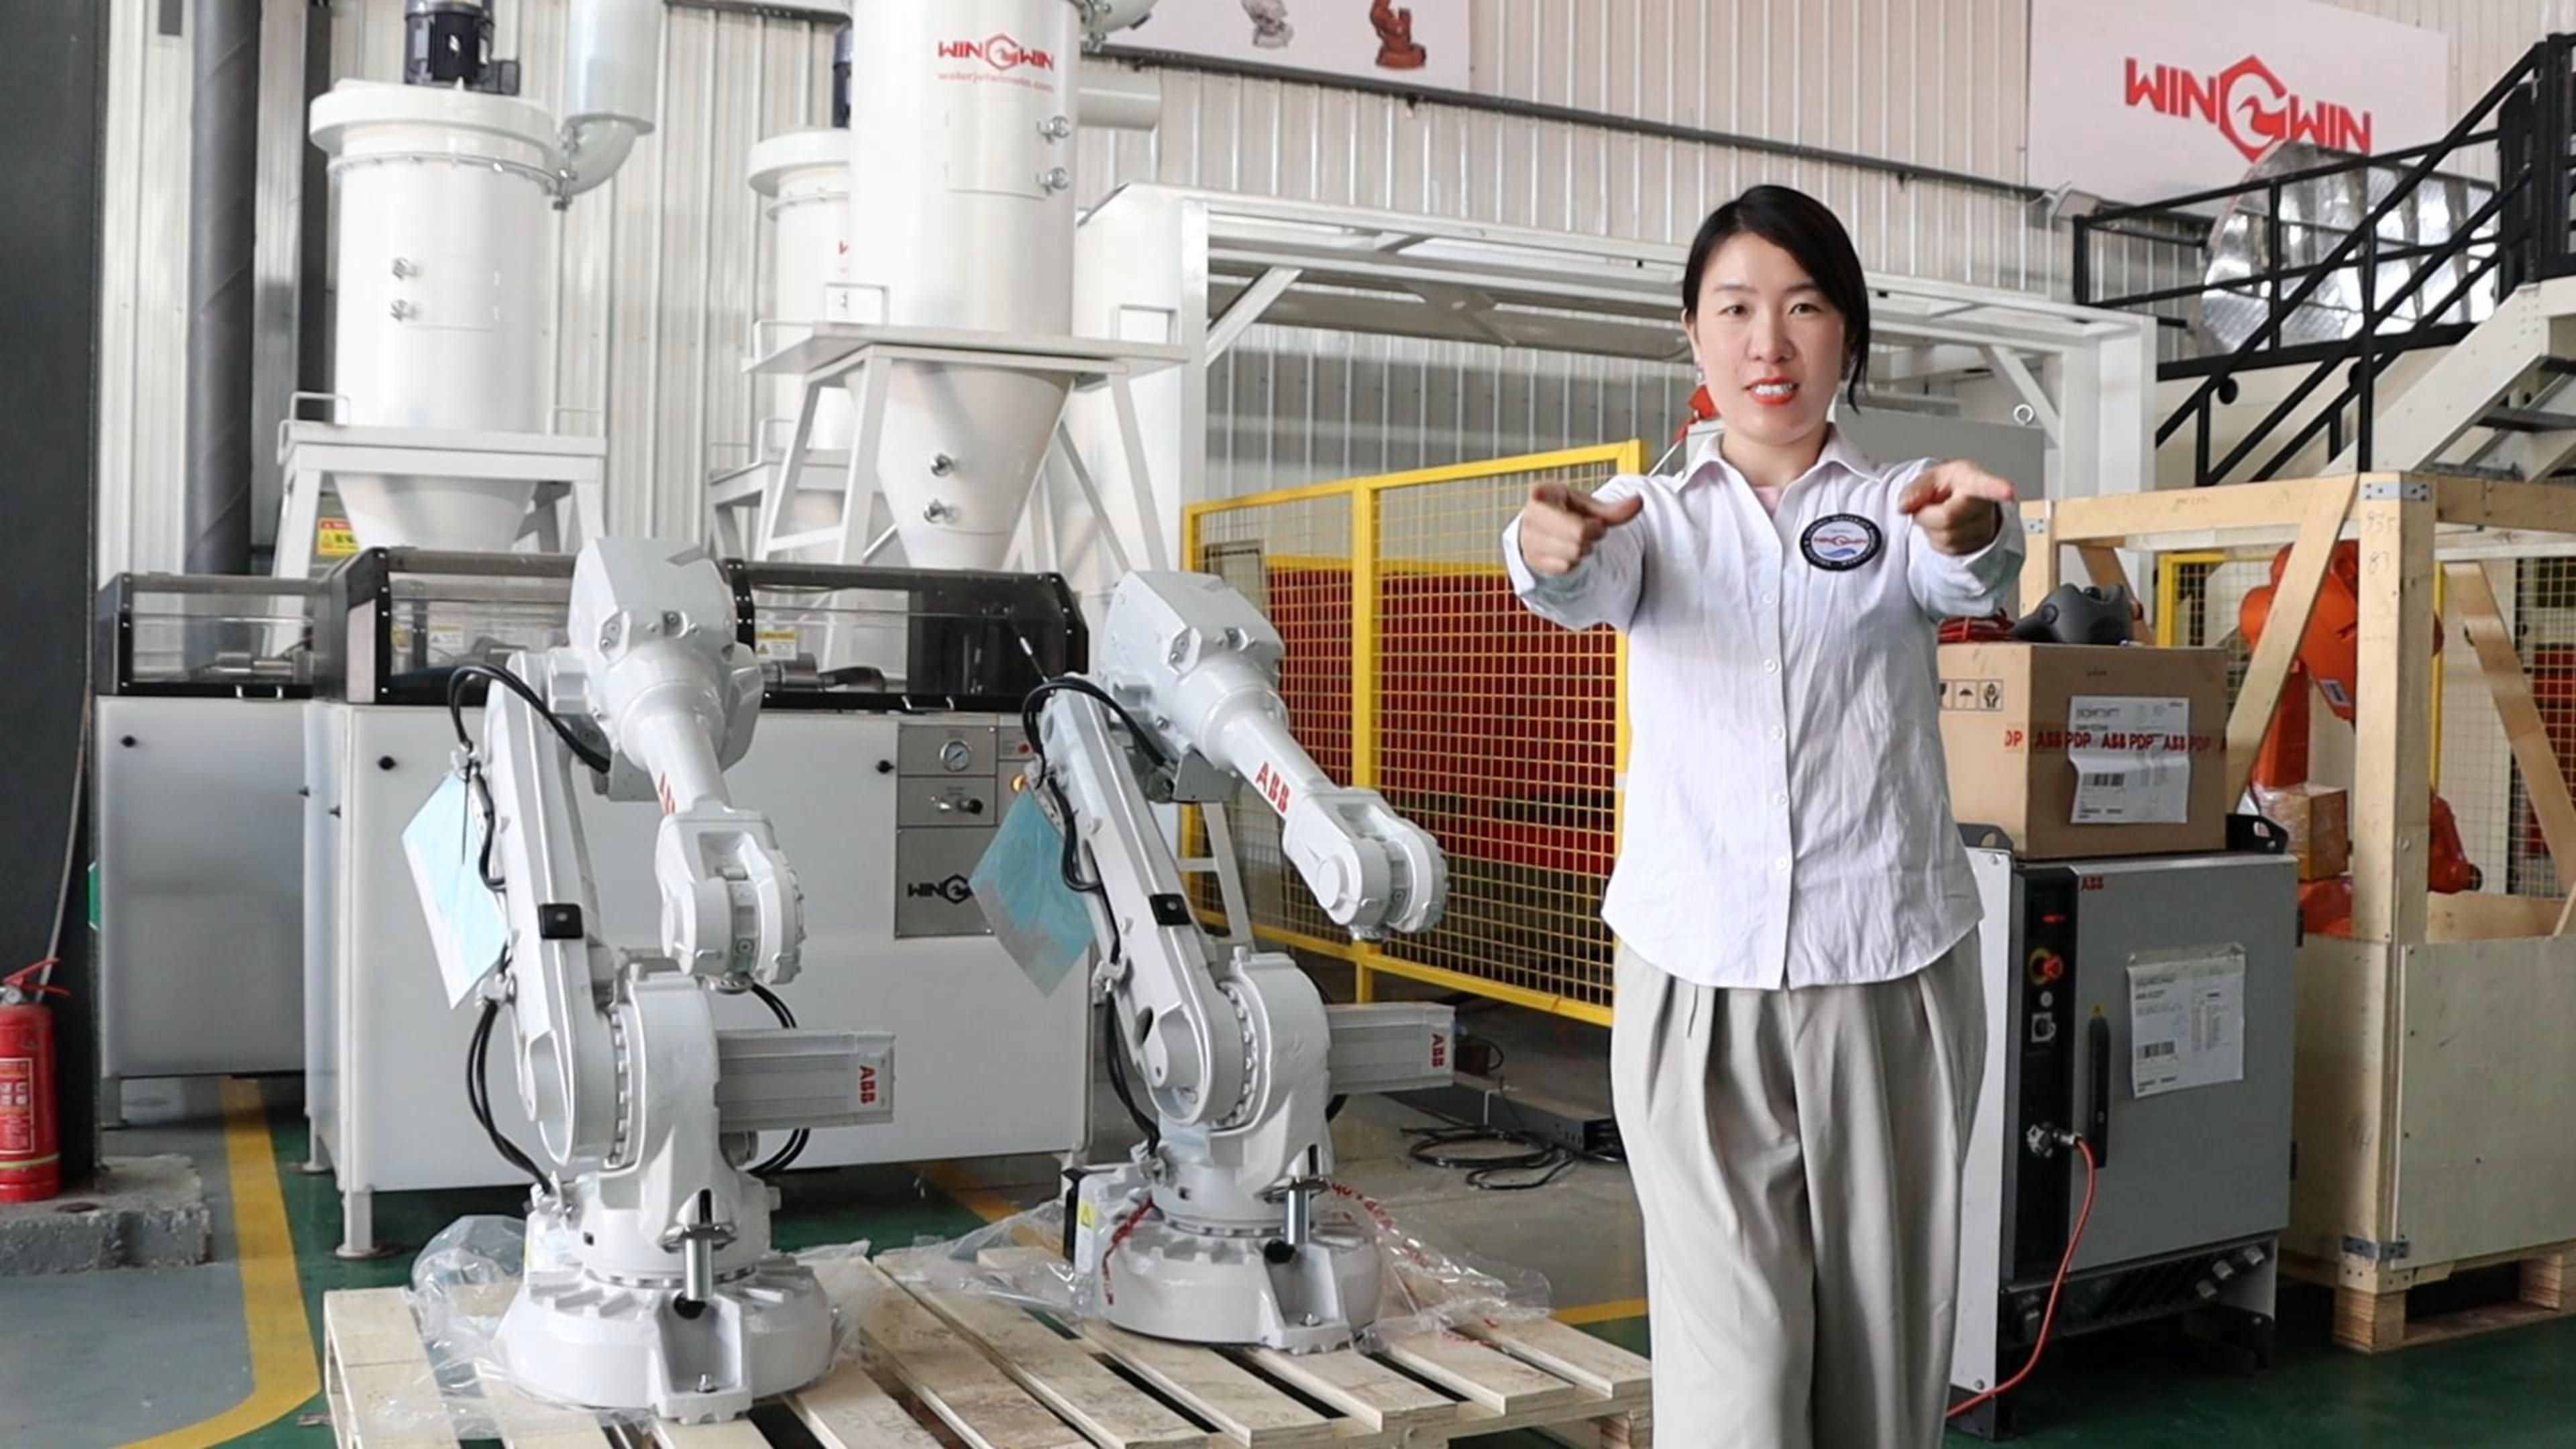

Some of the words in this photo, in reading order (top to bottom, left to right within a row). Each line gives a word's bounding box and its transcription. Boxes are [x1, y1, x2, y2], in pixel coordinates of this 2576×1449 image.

[2125, 54, 2371, 163] WINGWIN
[2035, 731, 2062, 749] ABB
[2065, 731, 2091, 749] PDP
[2102, 732, 2127, 749] ABB
[2129, 732, 2154, 750] PDP
[2163, 735, 2186, 750] ABB
[1255, 761, 1289, 814] ABB
[2082, 875, 2104, 891] ABB
[1432, 1033, 1444, 1068] ABB
[859, 1065, 875, 1105] ABB
